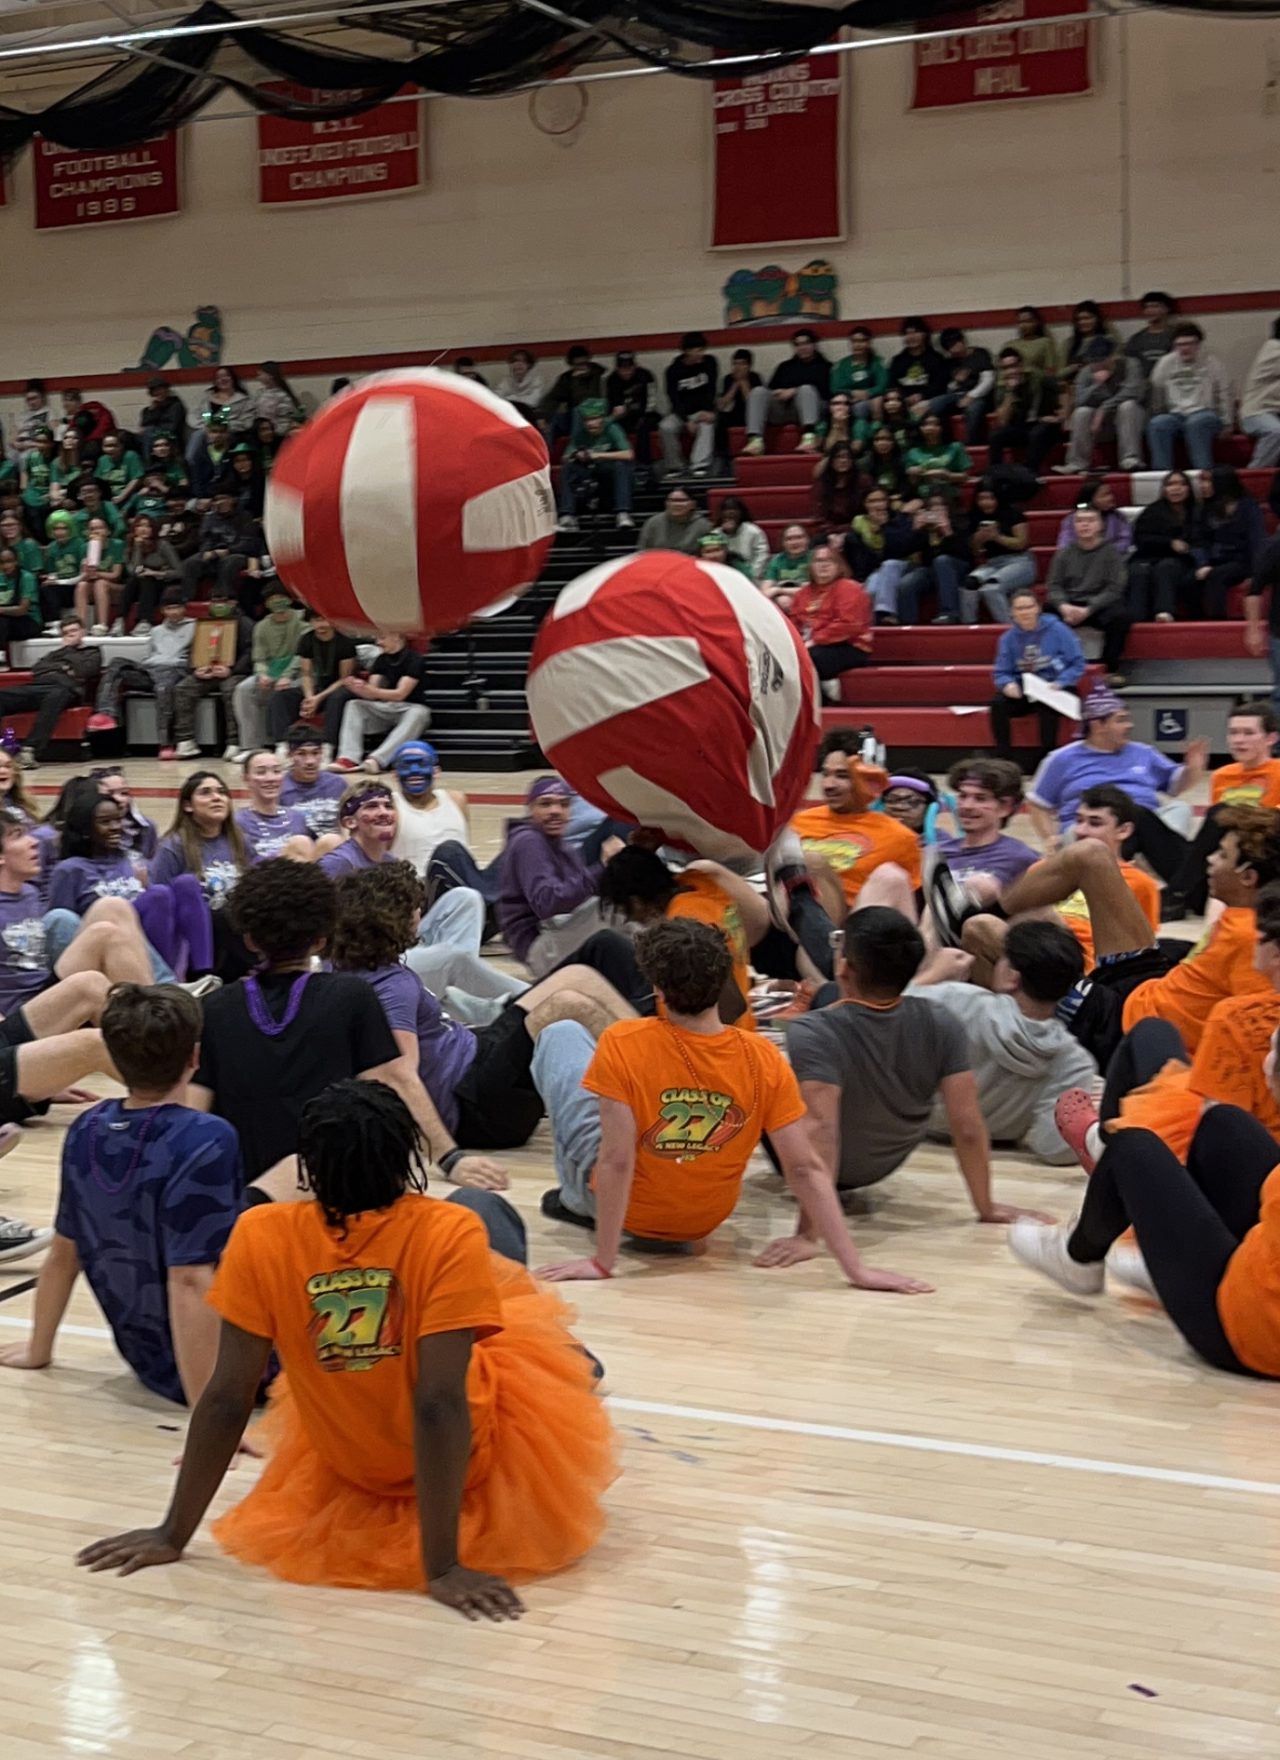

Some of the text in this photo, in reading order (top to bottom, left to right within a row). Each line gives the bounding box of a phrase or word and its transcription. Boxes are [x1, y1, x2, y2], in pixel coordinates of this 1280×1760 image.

[53, 151, 158, 177] FOOTBALL
[289, 162, 388, 191] CHAMPIONS
[49, 172, 163, 199] CHAMPIONS
[661, 1088, 733, 1108] CLASS OF
[655, 1102, 727, 1143] 27
[665, 1142, 686, 1150] NEW
[686, 1142, 720, 1152] LEGACY
[306, 1267, 393, 1294] CLASS OF
[313, 1287, 389, 1350] 27
